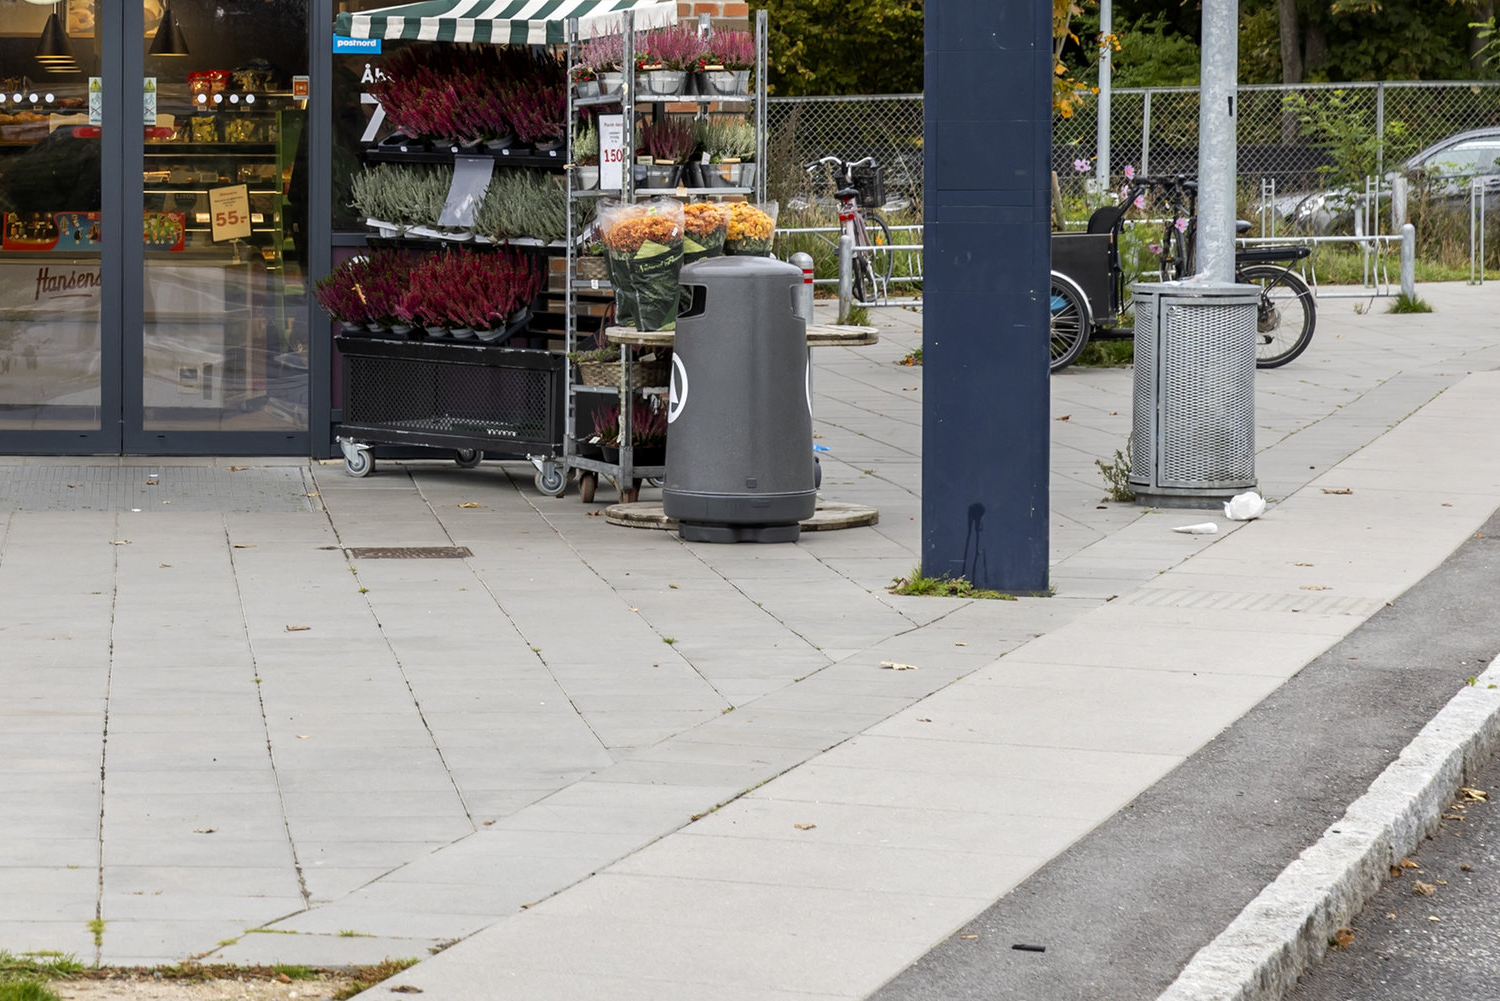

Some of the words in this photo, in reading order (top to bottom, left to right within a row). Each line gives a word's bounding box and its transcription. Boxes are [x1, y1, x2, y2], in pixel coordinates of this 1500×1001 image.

[336, 39, 377, 48] postnord
[360, 92, 386, 142] 7
[604, 149, 623, 163] 150
[35, 267, 102, 300] Hansens
